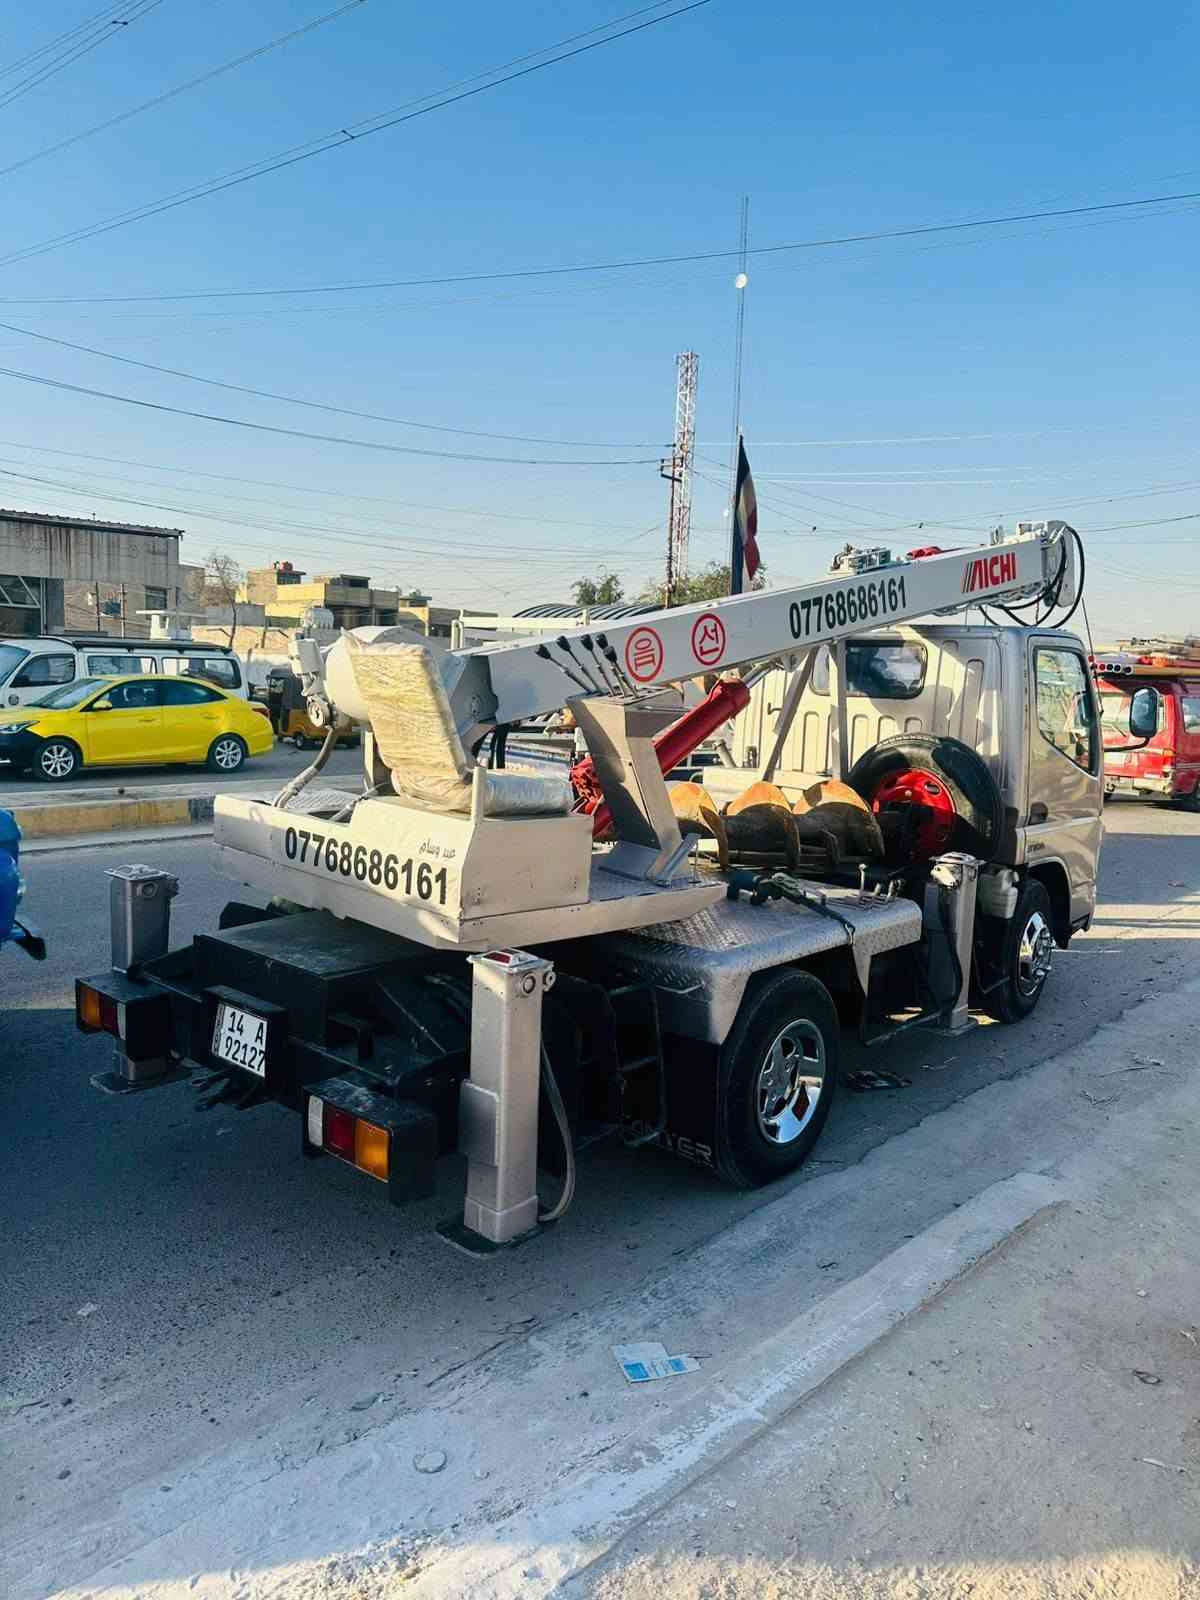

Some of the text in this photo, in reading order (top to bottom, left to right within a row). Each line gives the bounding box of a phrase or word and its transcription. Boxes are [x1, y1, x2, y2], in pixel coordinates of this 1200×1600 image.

[963, 552, 1017, 592] AICHI
[789, 576, 907, 639] 07768686161
[699, 623, 720, 656] 선
[285, 827, 448, 905] 07768686161
[228, 1011, 244, 1036] 14
[254, 1022, 264, 1045] A
[225, 1036, 265, 1071] 92127
